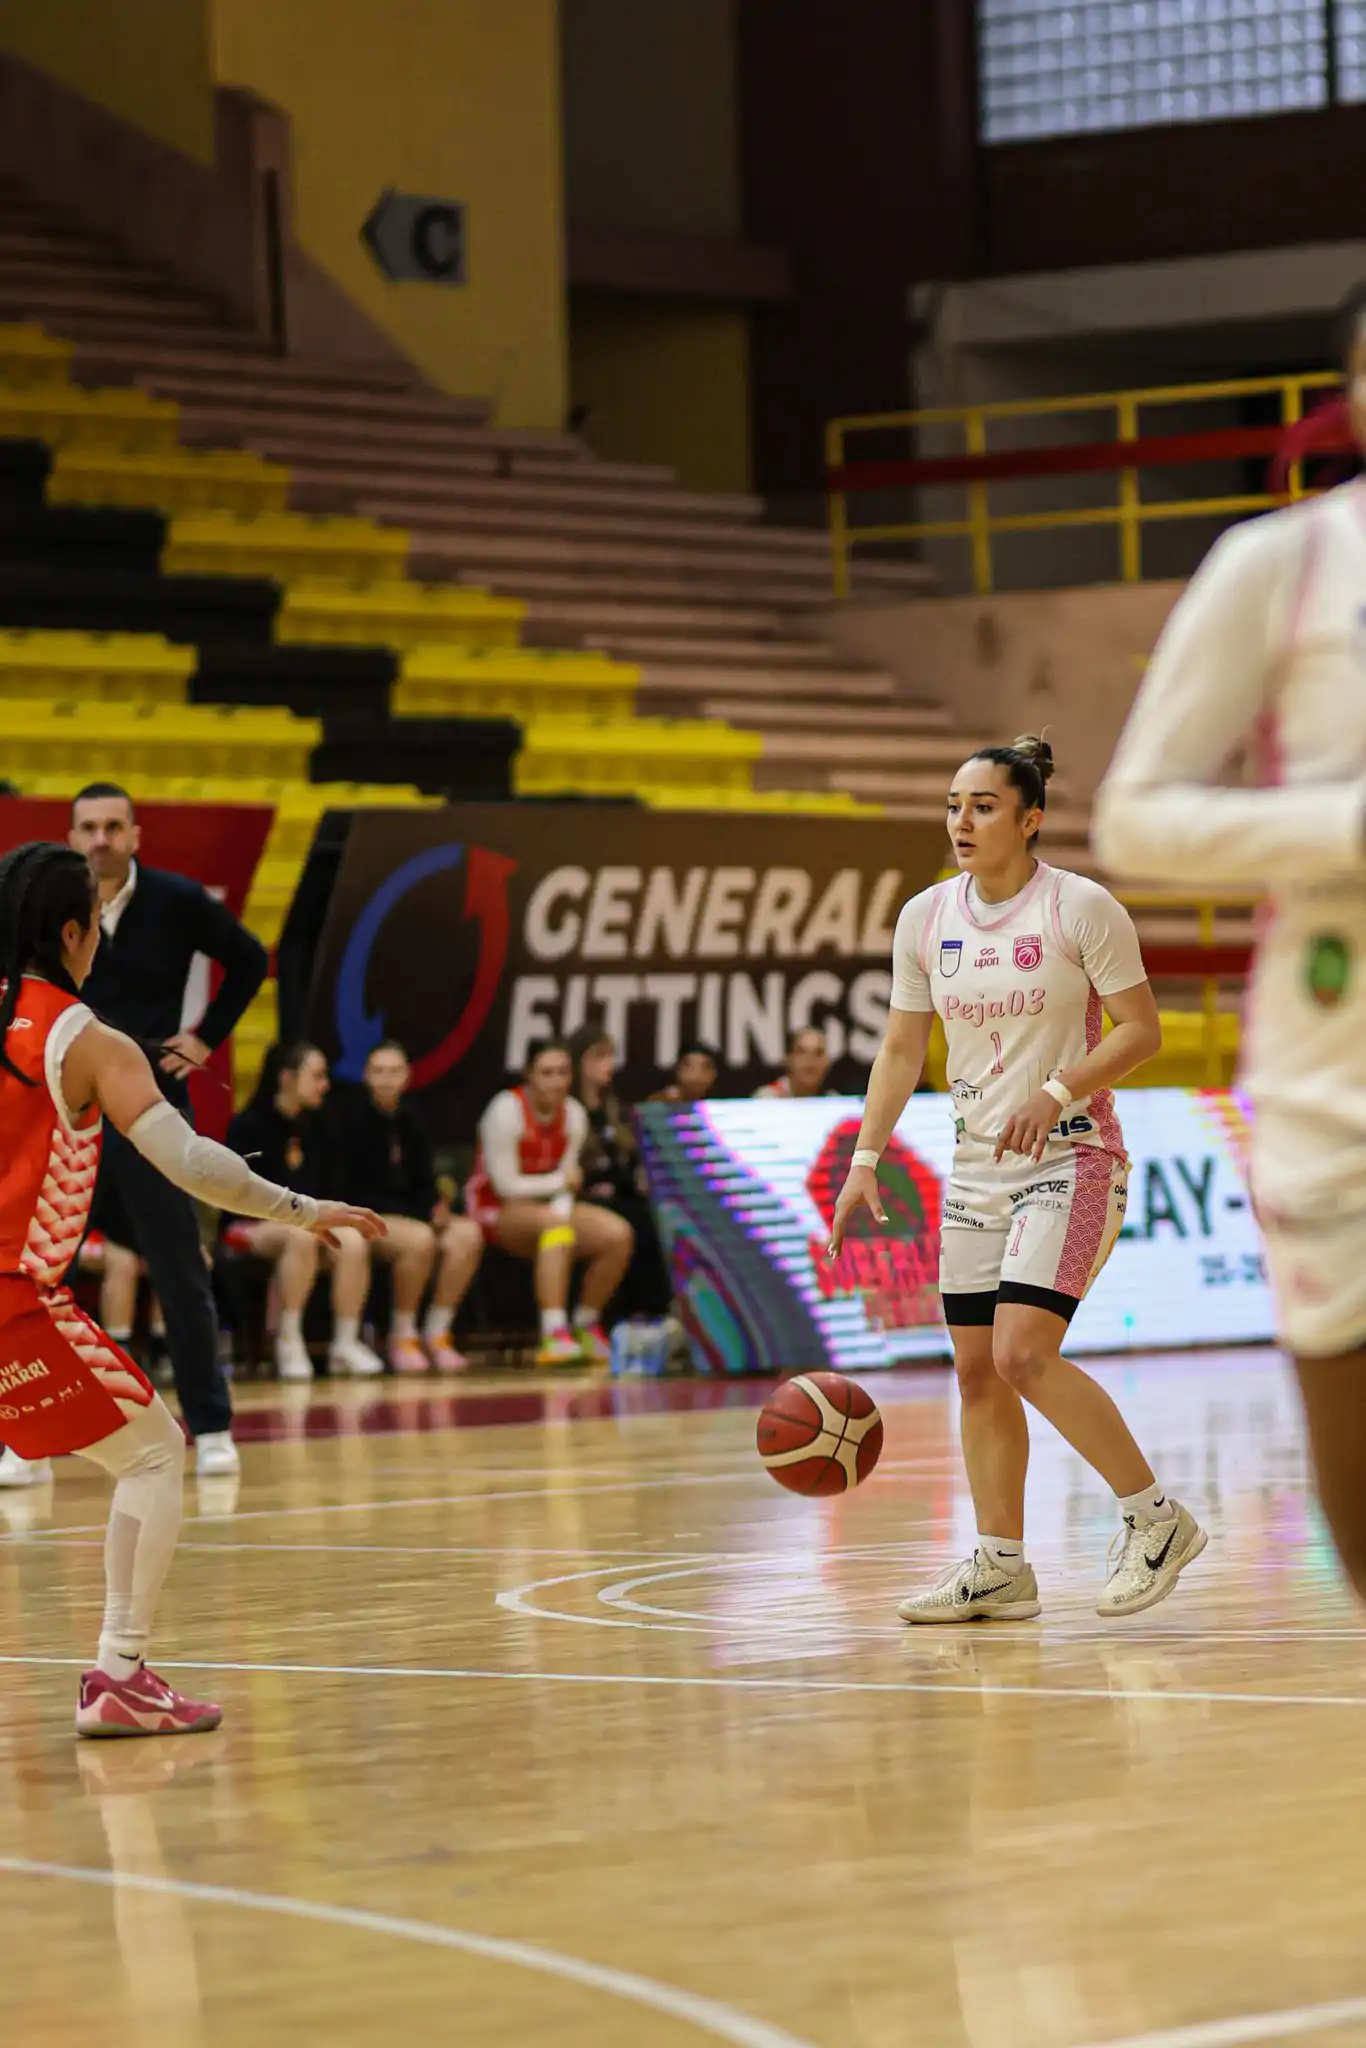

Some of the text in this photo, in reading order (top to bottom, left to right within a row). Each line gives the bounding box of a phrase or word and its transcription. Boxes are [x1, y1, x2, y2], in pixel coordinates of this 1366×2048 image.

[412, 204, 461, 277] C
[525, 865, 903, 960] GENERAL
[974, 956, 999, 969] upon
[506, 971, 892, 1070] FITTINGS
[943, 988, 1046, 1027] Peja03
[990, 1031, 1004, 1075] 1
[1009, 1215, 1028, 1256] 1
